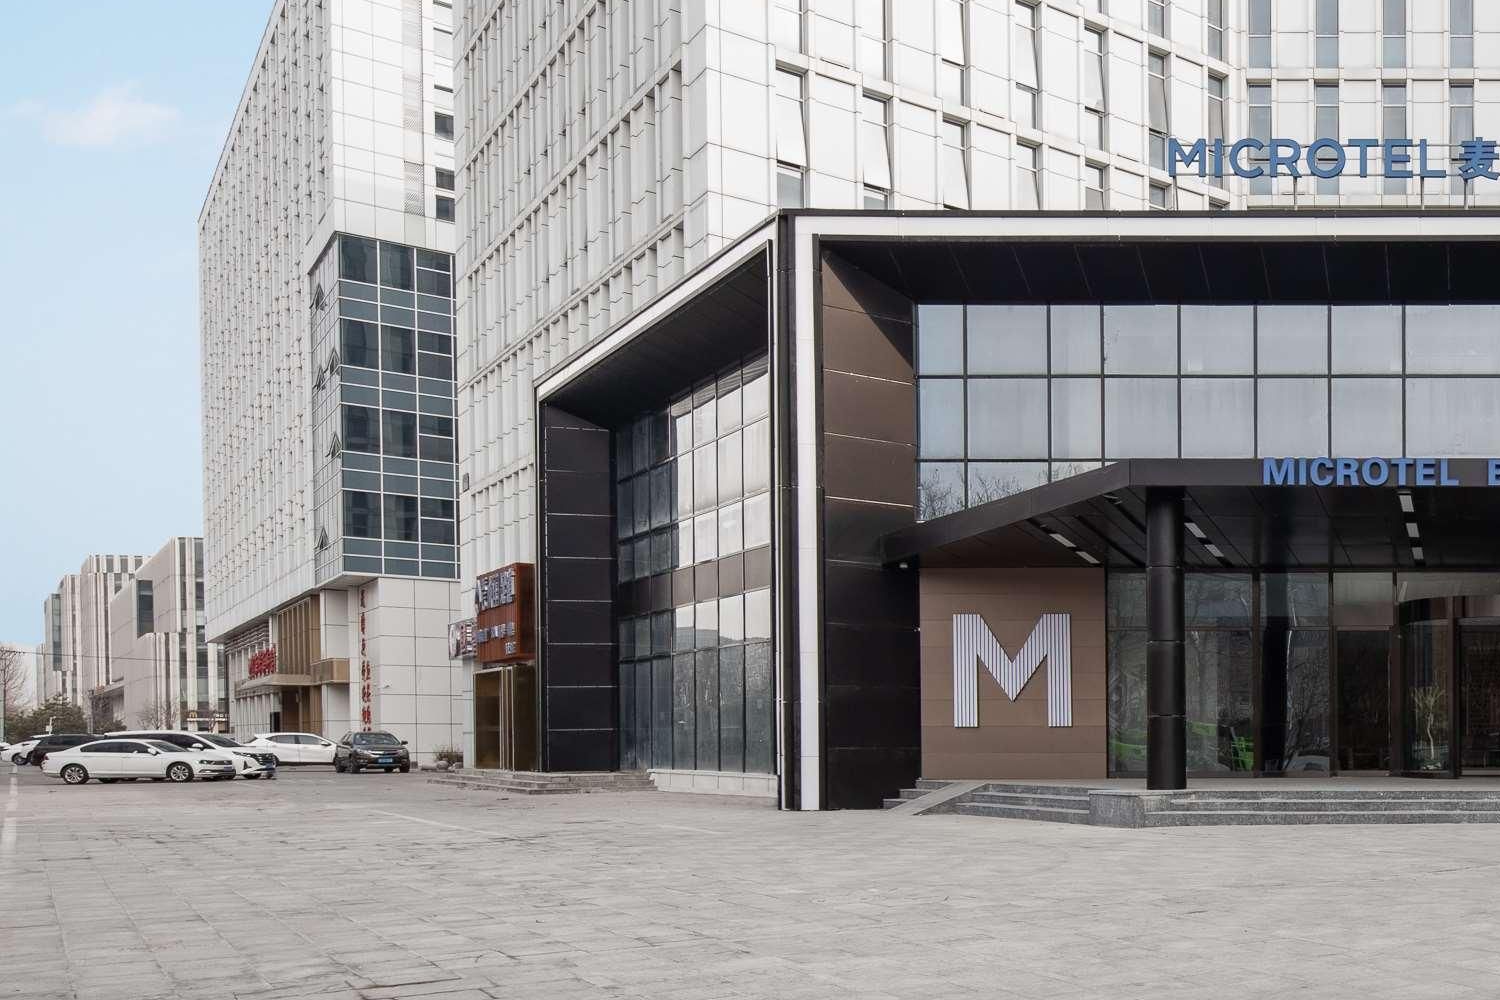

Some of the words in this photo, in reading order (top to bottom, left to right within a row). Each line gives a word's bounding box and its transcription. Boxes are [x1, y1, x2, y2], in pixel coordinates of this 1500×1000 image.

[1168, 137, 1447, 179] MICROTEL
[1262, 457, 1459, 487] MICROTEL
[952, 614, 1072, 728] M
